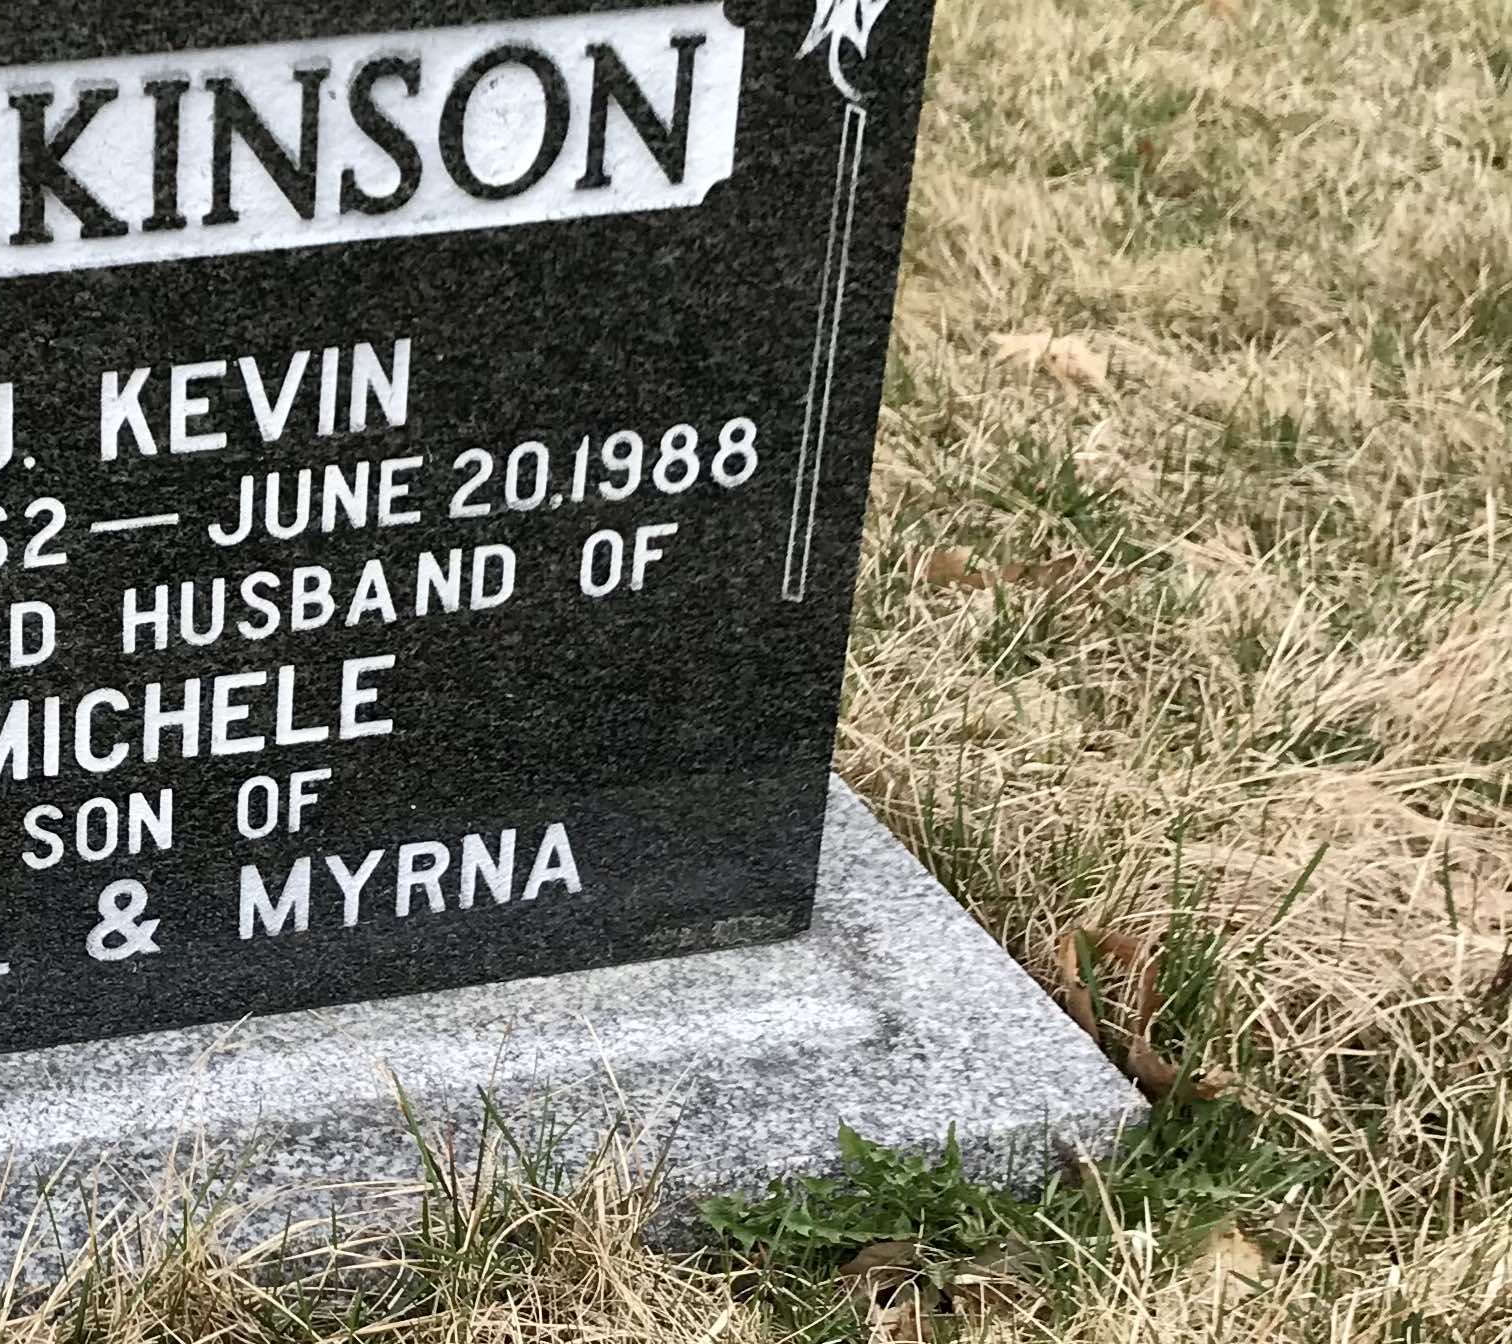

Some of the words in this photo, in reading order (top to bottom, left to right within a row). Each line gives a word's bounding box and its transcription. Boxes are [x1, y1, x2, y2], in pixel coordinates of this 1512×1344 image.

[101, 339, 411, 461] KEVIN
[208, 456, 423, 546] JUNE
[122, 544, 516, 653] HUSBAND
[580, 523, 679, 597] OF
[22, 789, 173, 869] SON
[237, 768, 331, 840] OF
[86, 879, 160, 961] &
[239, 823, 582, 939] MYRNA
